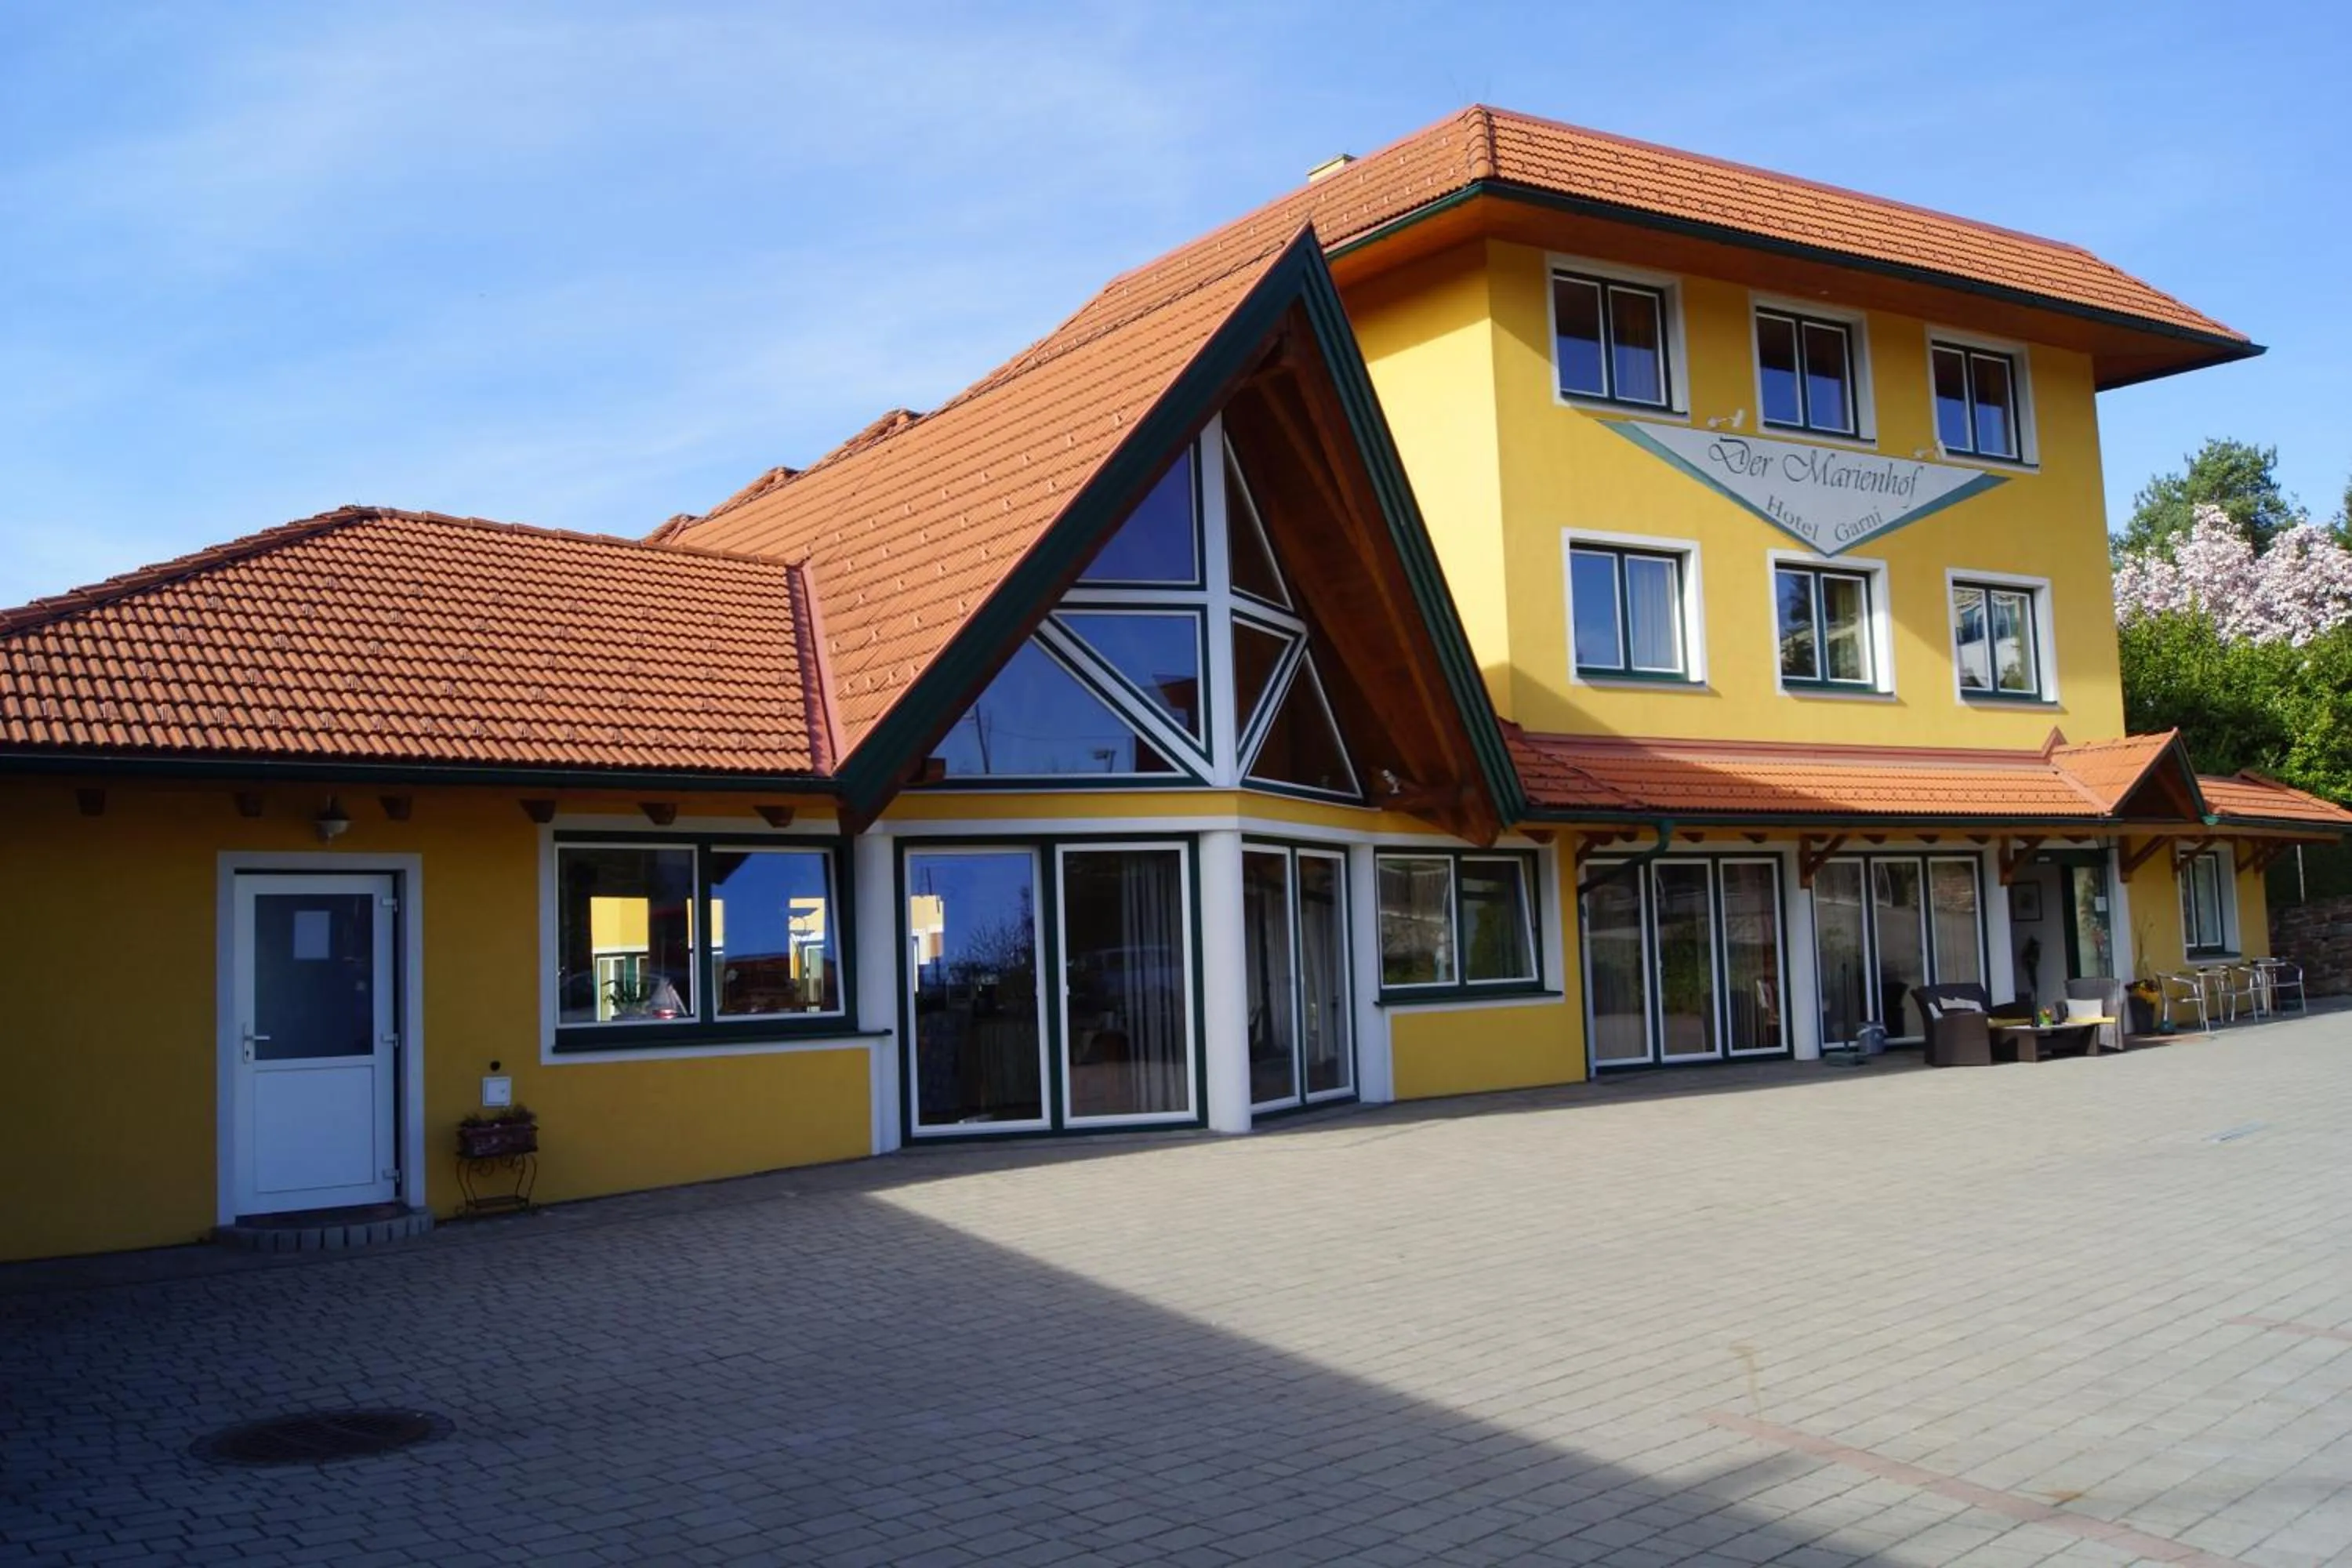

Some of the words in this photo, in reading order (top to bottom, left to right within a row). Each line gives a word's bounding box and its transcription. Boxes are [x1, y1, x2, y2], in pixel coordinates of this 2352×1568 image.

[1708, 436, 1774, 477] Der
[1782, 449, 1924, 508] Marienhof
[1766, 495, 1819, 541] Hotel
[1835, 506, 1882, 543] Garni
